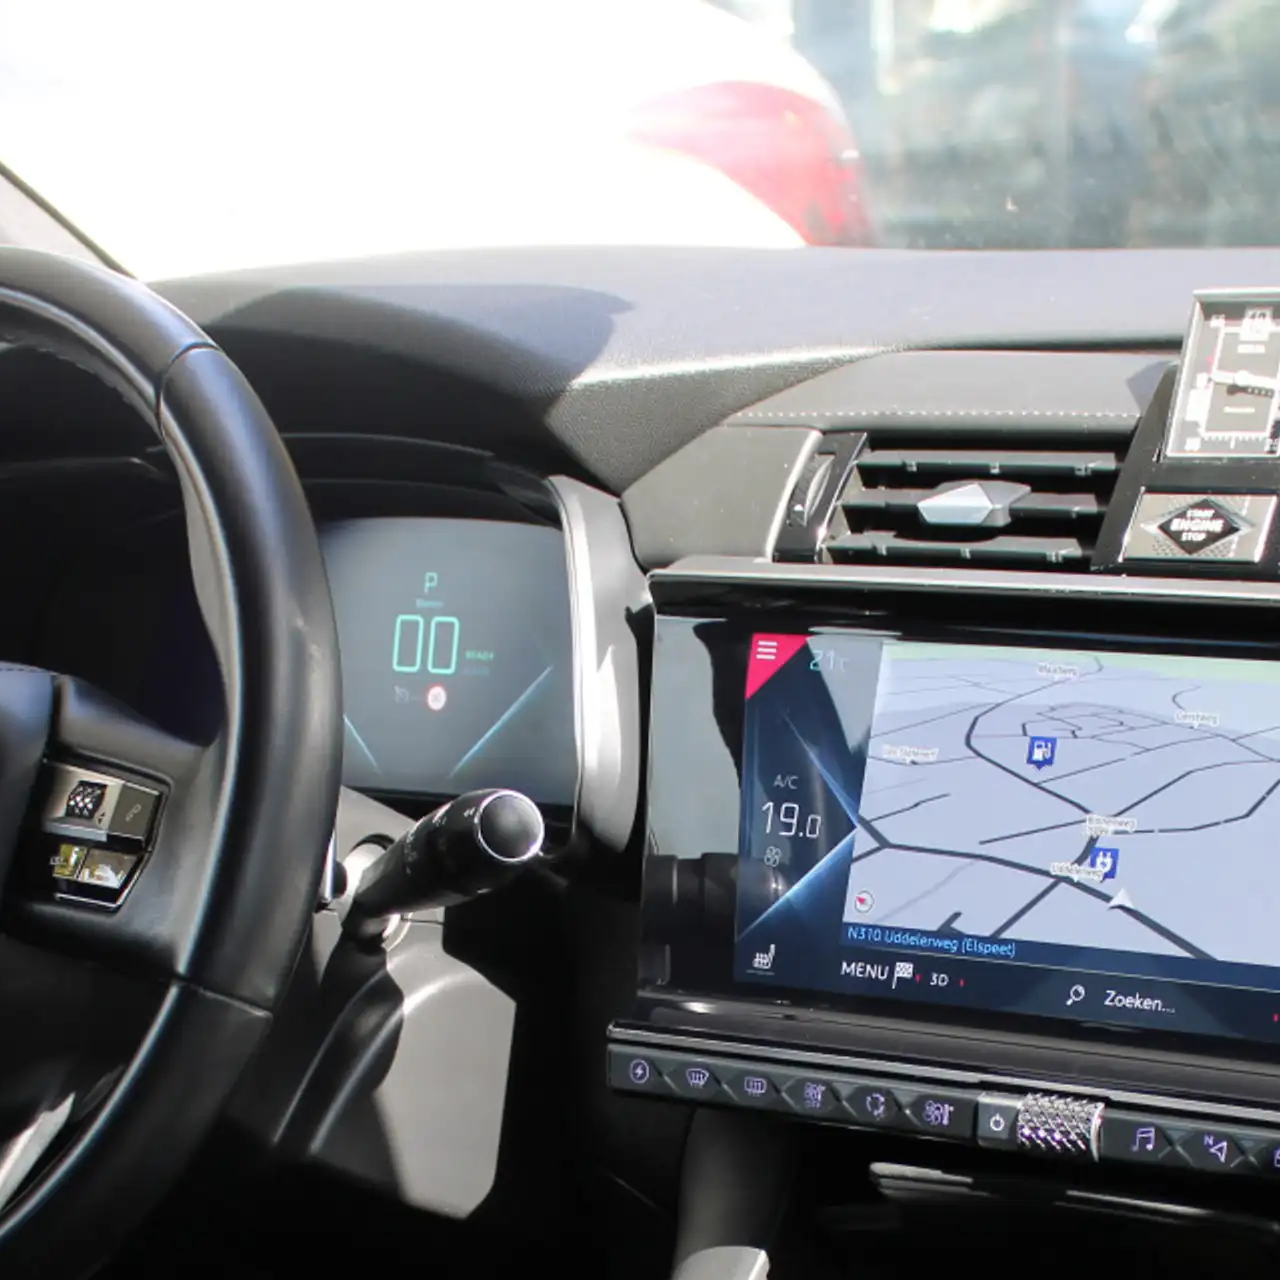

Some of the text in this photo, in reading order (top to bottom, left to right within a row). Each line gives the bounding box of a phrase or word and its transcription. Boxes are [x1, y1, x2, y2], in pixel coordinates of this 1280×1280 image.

[1186, 509, 1215, 518] START
[1170, 518, 1224, 533] ENGINE
[1181, 532, 1207, 541] STOP
[424, 572, 438, 593] P
[773, 774, 798, 789] A/C
[762, 802, 822, 839] 19.0
[847, 926, 1016, 958] N310 Uddelerweg (Elspeet)
[840, 961, 890, 980] MENU
[930, 973, 949, 987] 3D
